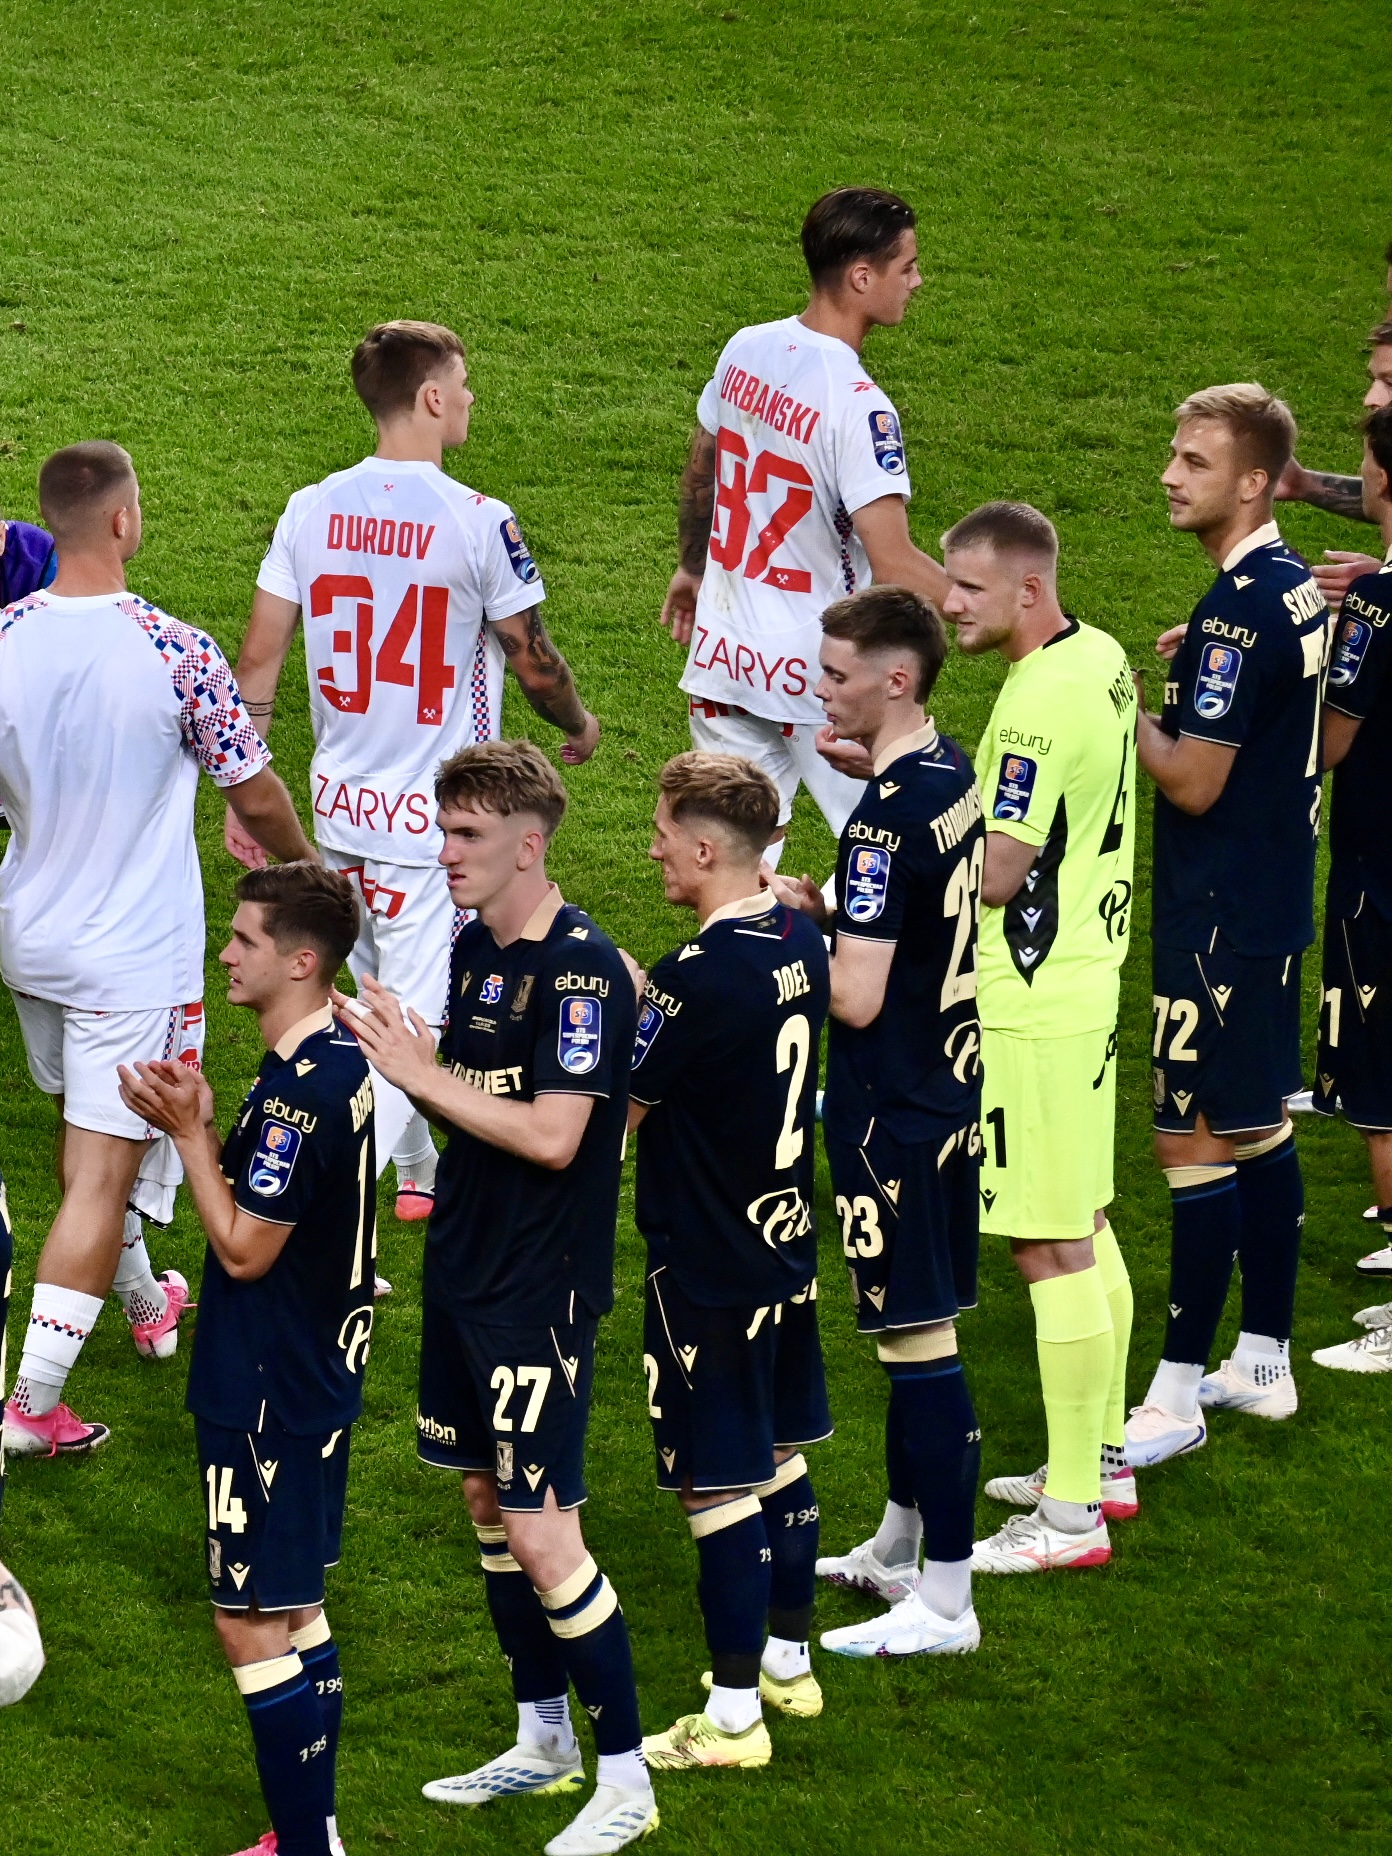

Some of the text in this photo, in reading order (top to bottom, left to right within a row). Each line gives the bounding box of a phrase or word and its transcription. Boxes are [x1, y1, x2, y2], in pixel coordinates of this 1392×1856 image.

[721, 363, 820, 445] URBAŃSKI
[327, 513, 435, 561] DURDOV
[309, 574, 455, 726] 34
[694, 625, 807, 698] ZARYS
[1201, 616, 1258, 649] ebury
[999, 726, 1053, 756] ebury
[314, 774, 430, 836] ZARYS
[848, 820, 901, 852] ebury
[479, 974, 504, 1005] STS
[555, 971, 610, 998] ebury
[772, 960, 811, 1006] JOEL
[1153, 994, 1199, 1062] 72
[263, 1097, 318, 1134] ebury
[774, 1014, 811, 1170] 2
[835, 1195, 884, 1258] 23
[490, 1366, 552, 1433] 27
[207, 1464, 248, 1534] 14
